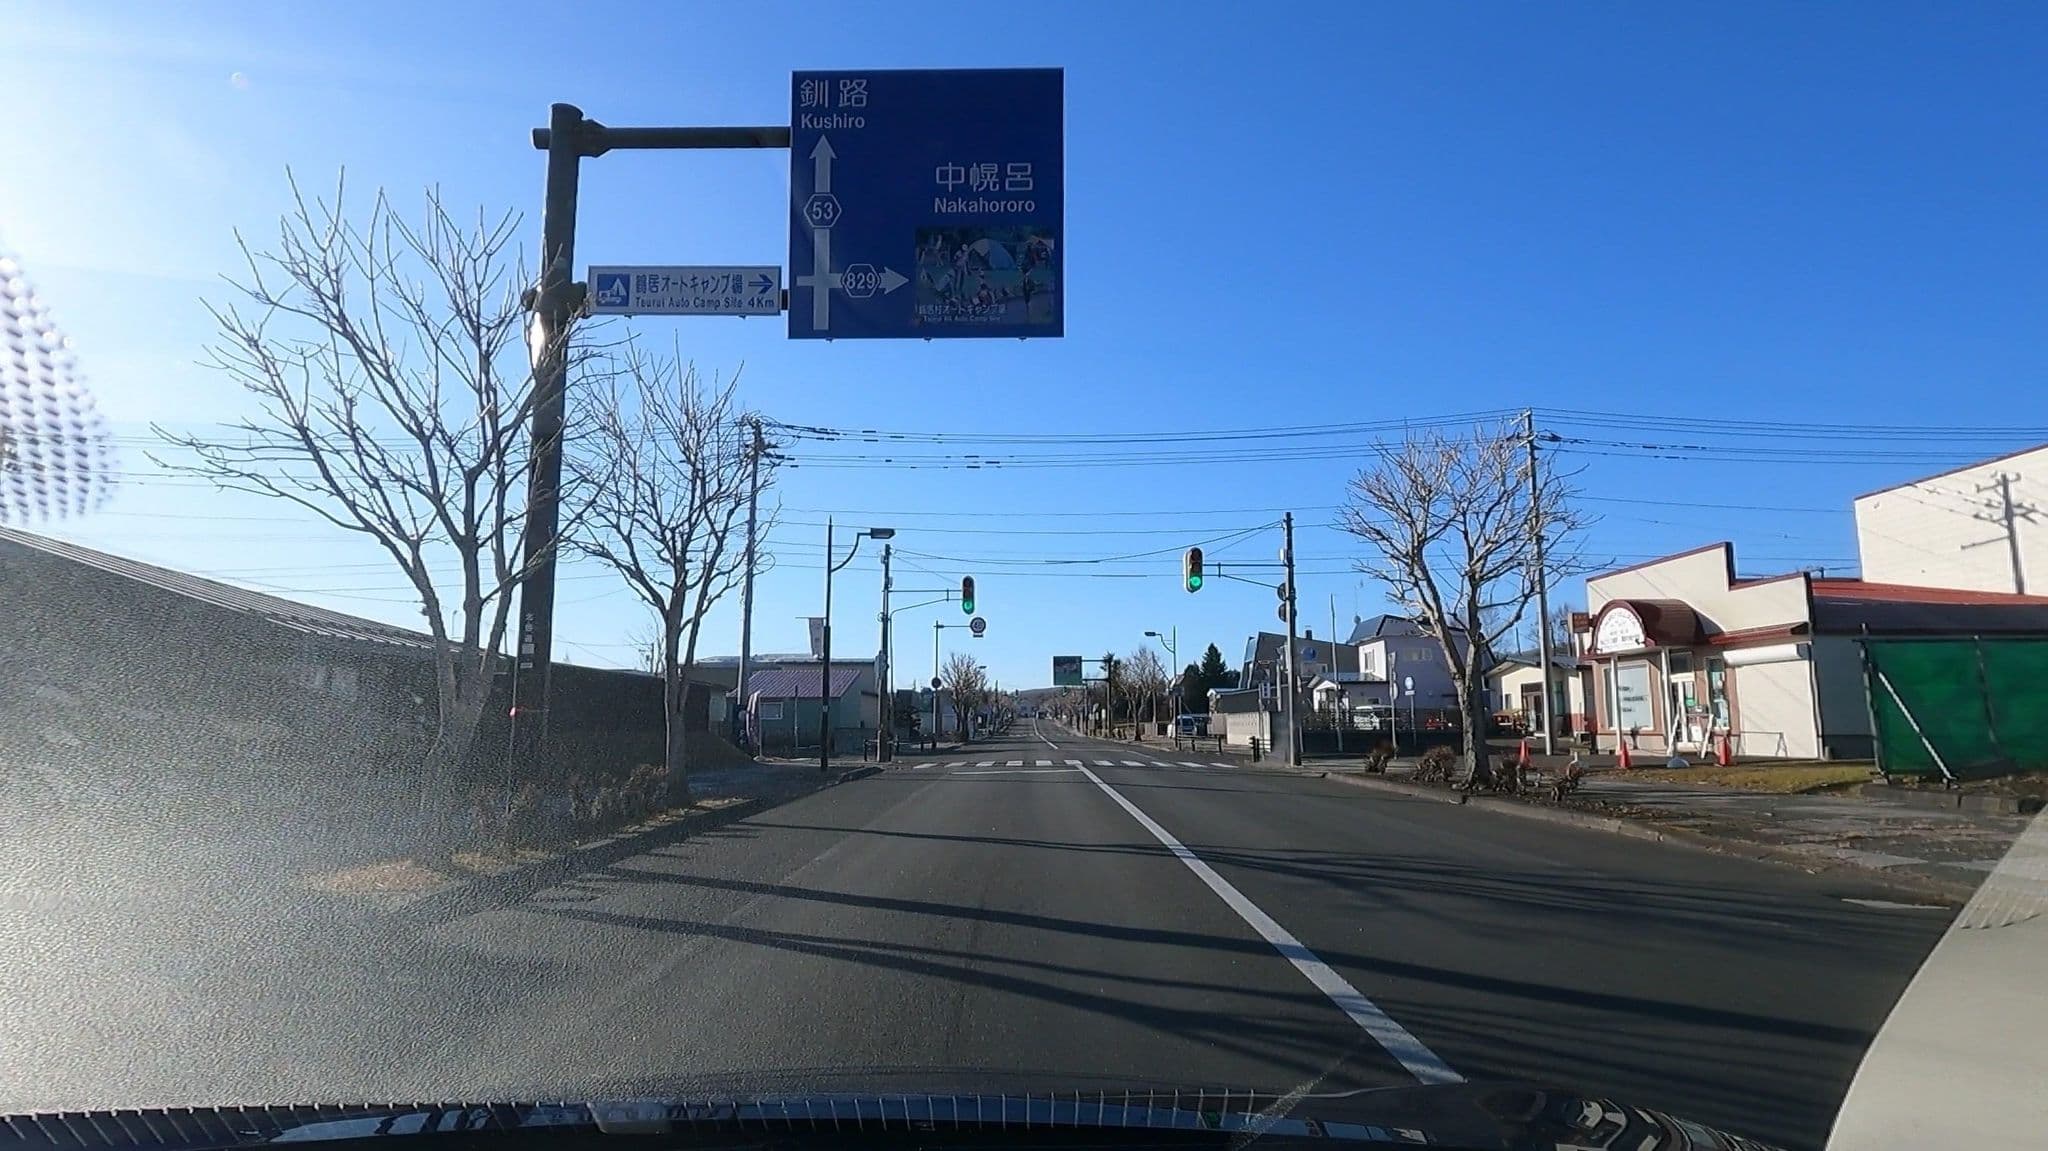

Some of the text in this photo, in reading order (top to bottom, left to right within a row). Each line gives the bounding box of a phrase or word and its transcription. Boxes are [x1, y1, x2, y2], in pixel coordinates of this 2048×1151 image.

[800, 79, 868, 108] 釧路
[801, 113, 865, 129] Kushiro
[936, 162, 1033, 192] 中幌呂
[812, 201, 834, 220] 53
[934, 197, 1036, 214] Nakahororo
[846, 272, 876, 290] 829
[668, 297, 690, 308] Auto
[693, 297, 719, 310] Camp
[723, 297, 743, 308] Site
